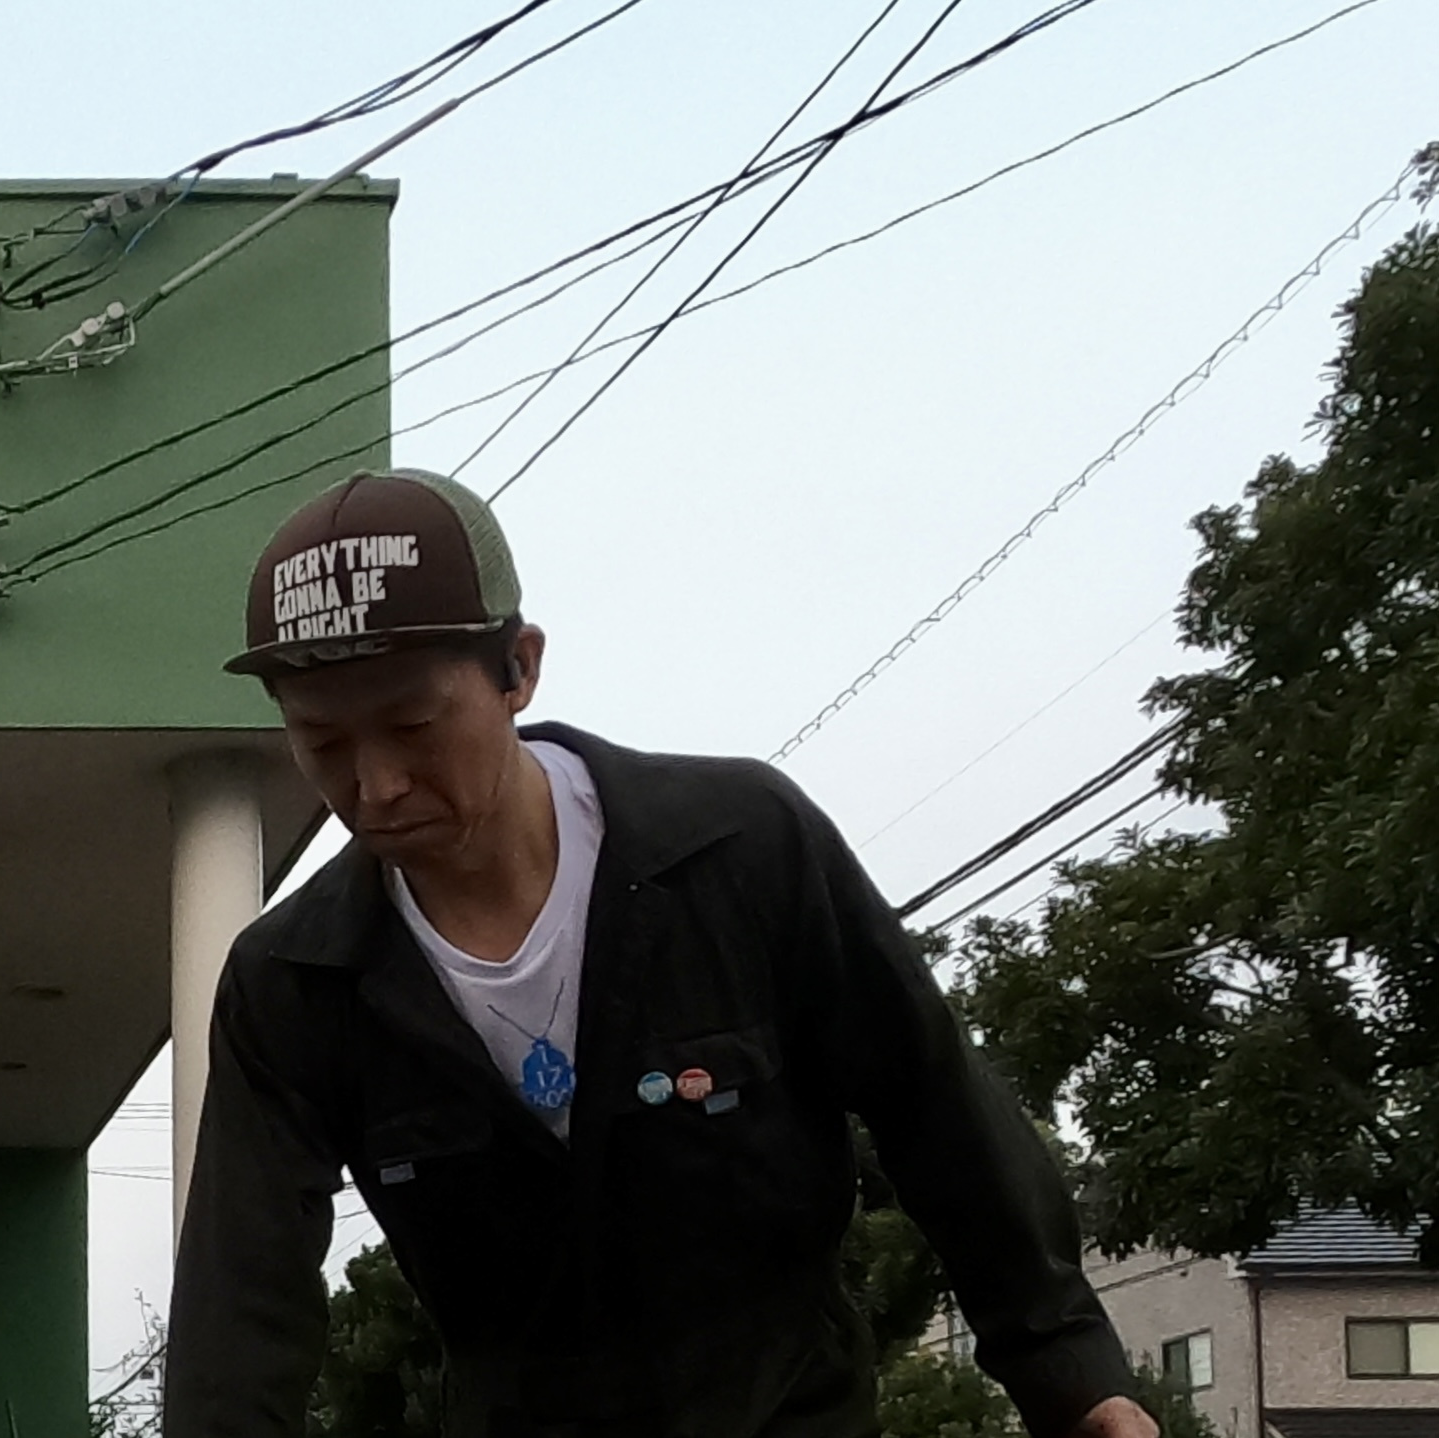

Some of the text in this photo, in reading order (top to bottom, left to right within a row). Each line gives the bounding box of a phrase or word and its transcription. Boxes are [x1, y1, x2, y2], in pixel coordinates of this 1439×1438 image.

[273, 535, 419, 593] EVERYTHING
[274, 568, 386, 624] GONNA BE
